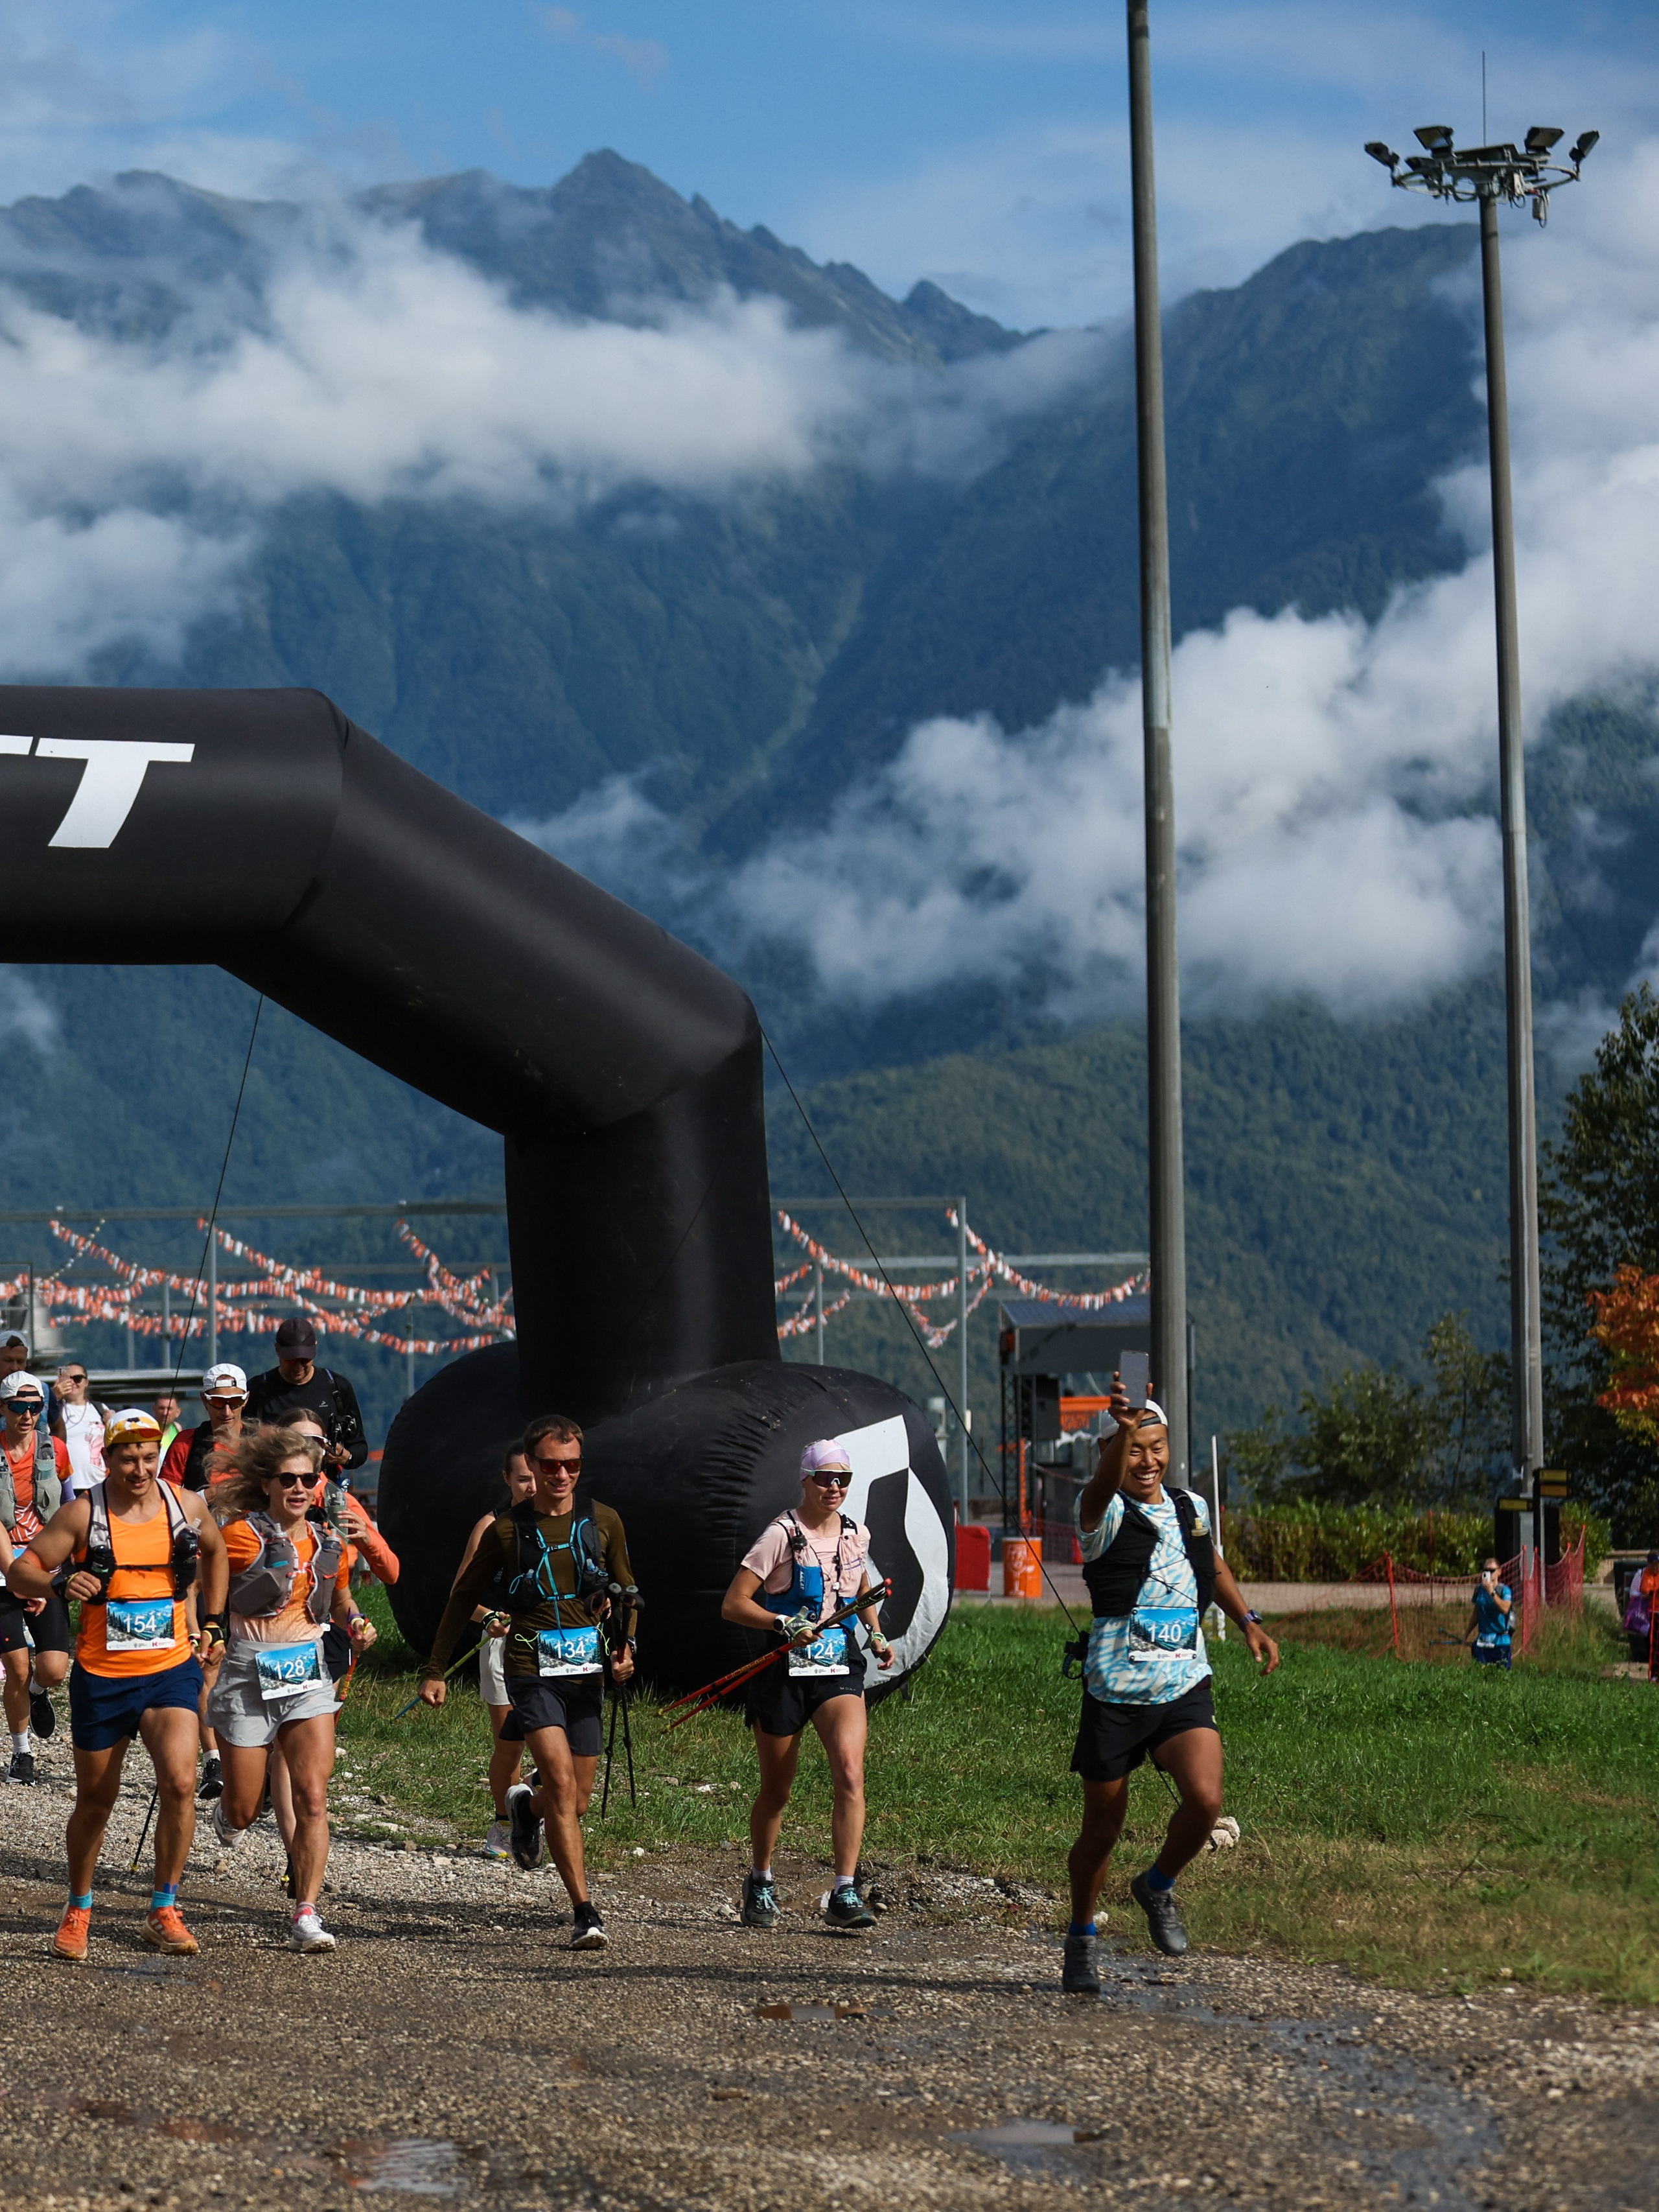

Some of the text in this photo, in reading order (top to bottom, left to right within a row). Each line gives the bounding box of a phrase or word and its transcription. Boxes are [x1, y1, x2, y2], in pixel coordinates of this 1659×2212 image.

[123, 1614, 157, 1633] 154
[1148, 1623, 1183, 1642] 140
[554, 1640, 586, 1659] 134
[806, 1642, 835, 1660] 124
[273, 1659, 305, 1681] 128
